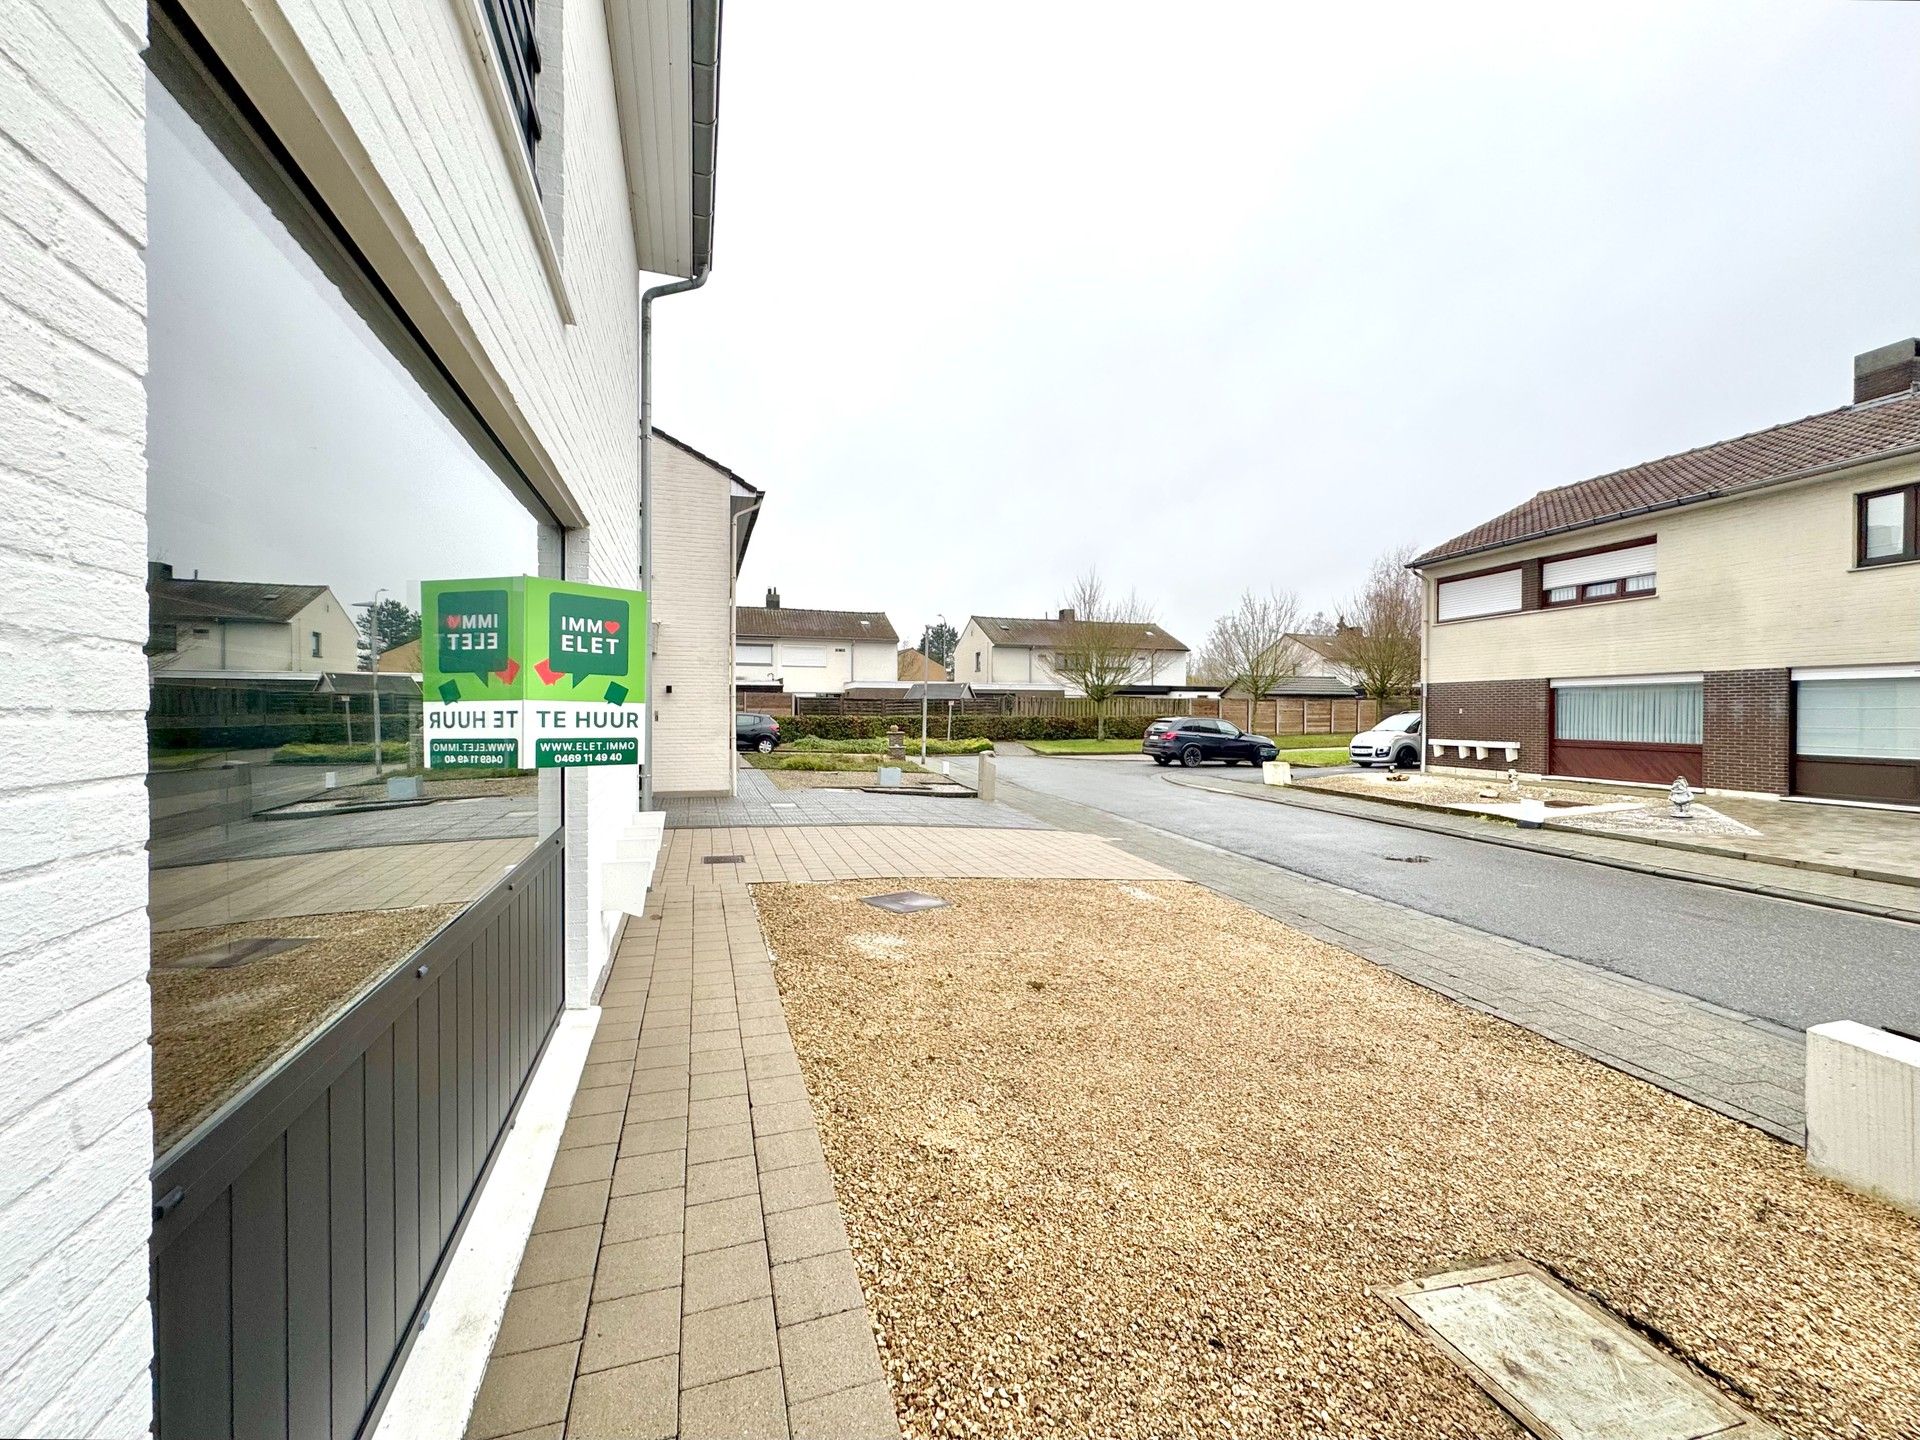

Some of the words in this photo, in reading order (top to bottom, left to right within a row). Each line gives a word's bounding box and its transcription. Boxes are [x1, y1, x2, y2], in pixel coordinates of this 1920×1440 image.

[561, 634, 620, 655] ELET
[536, 711, 566, 728] TE
[575, 711, 639, 728] HUUR
[540, 741, 635, 752] WWW.ELET.IMMO
[554, 754, 582, 763] 0469
[583, 753, 593, 762] 11
[594, 753, 608, 762] 49
[609, 753, 622, 762] 40
